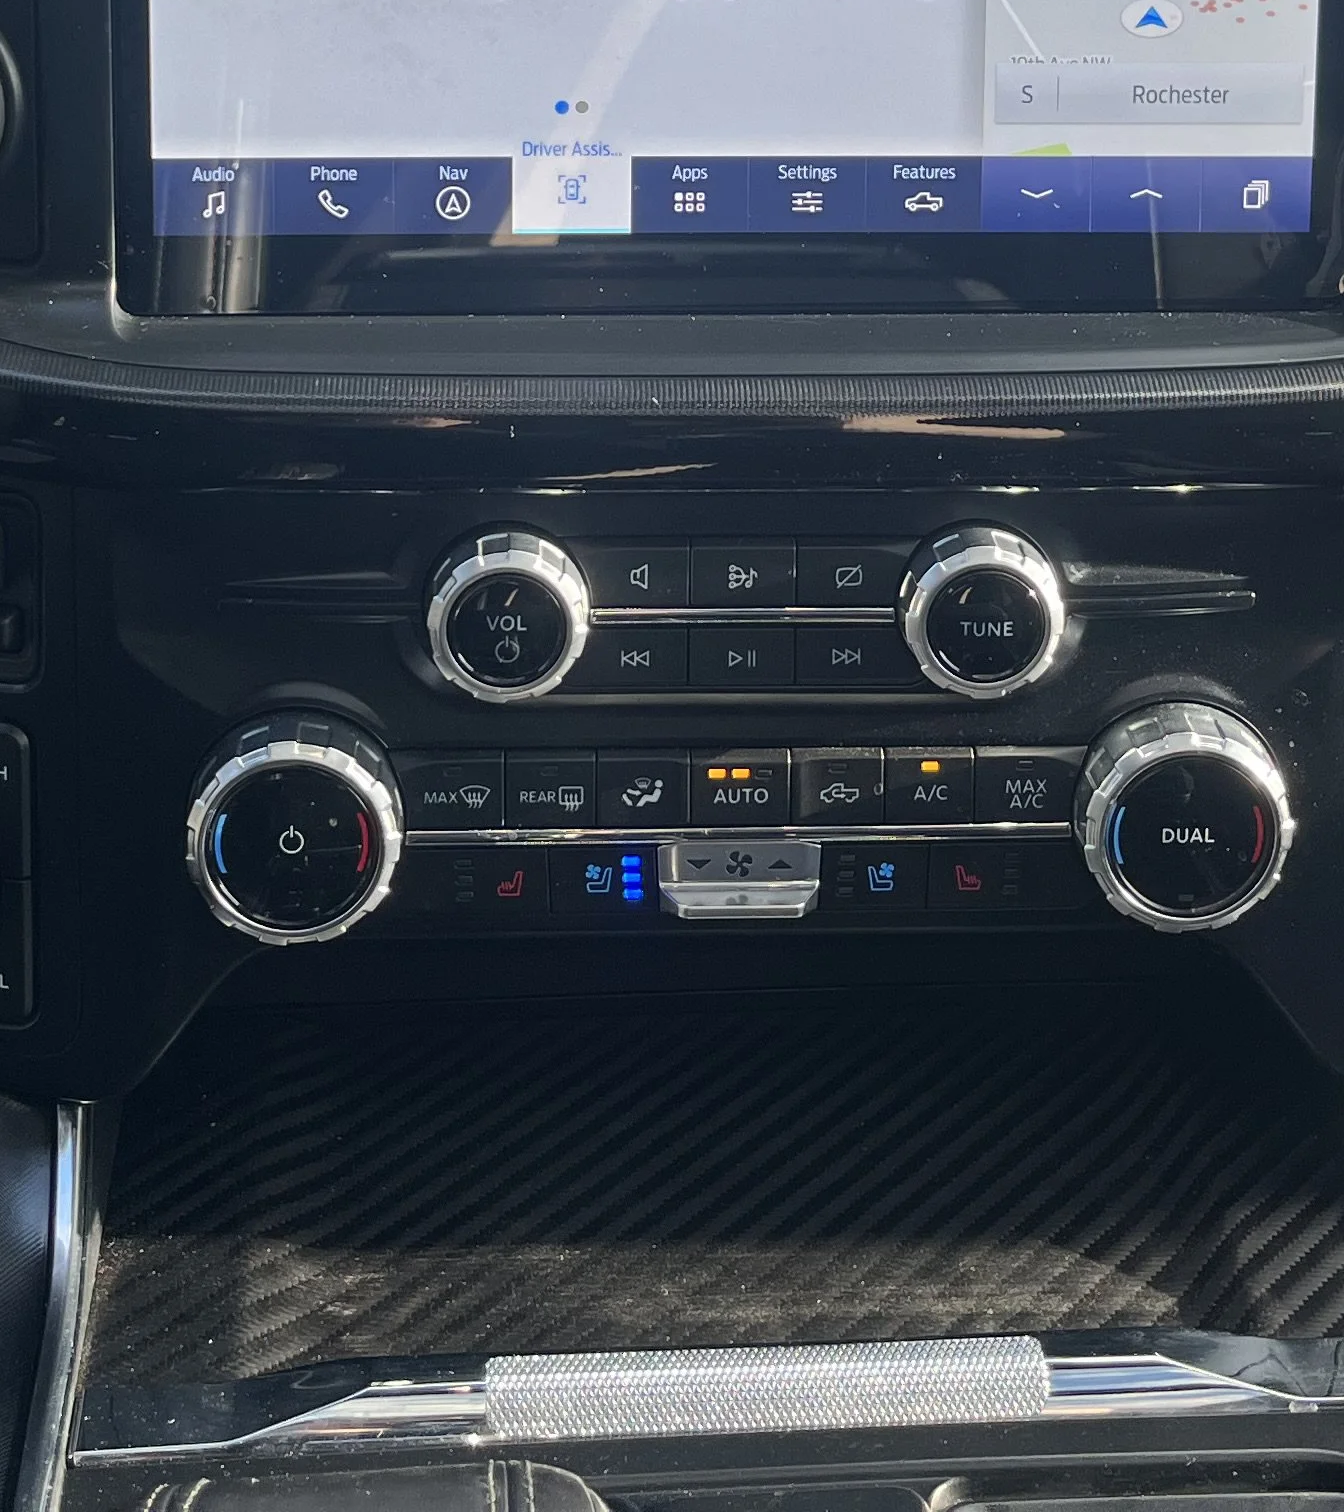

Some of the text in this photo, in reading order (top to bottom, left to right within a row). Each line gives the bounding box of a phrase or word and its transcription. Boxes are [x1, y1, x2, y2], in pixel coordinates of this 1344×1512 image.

[1021, 85, 1034, 105] S
[1132, 85, 1230, 105] Rochester
[522, 140, 567, 157] Driver
[192, 165, 236, 183] Audio
[310, 164, 358, 182] Phone
[439, 165, 469, 182] Nav
[671, 164, 709, 184] Apps
[778, 163, 838, 183] Settings
[893, 163, 957, 181] Features
[485, 614, 528, 633] VOL
[959, 620, 1014, 638] TUNE
[913, 784, 949, 803] A/C
[1005, 778, 1048, 794] MAX
[423, 791, 458, 805] MAX
[519, 790, 557, 804] REAR
[713, 788, 770, 805] AUTO
[1008, 792, 1045, 811] A/C
[1160, 827, 1216, 845] DUAL
